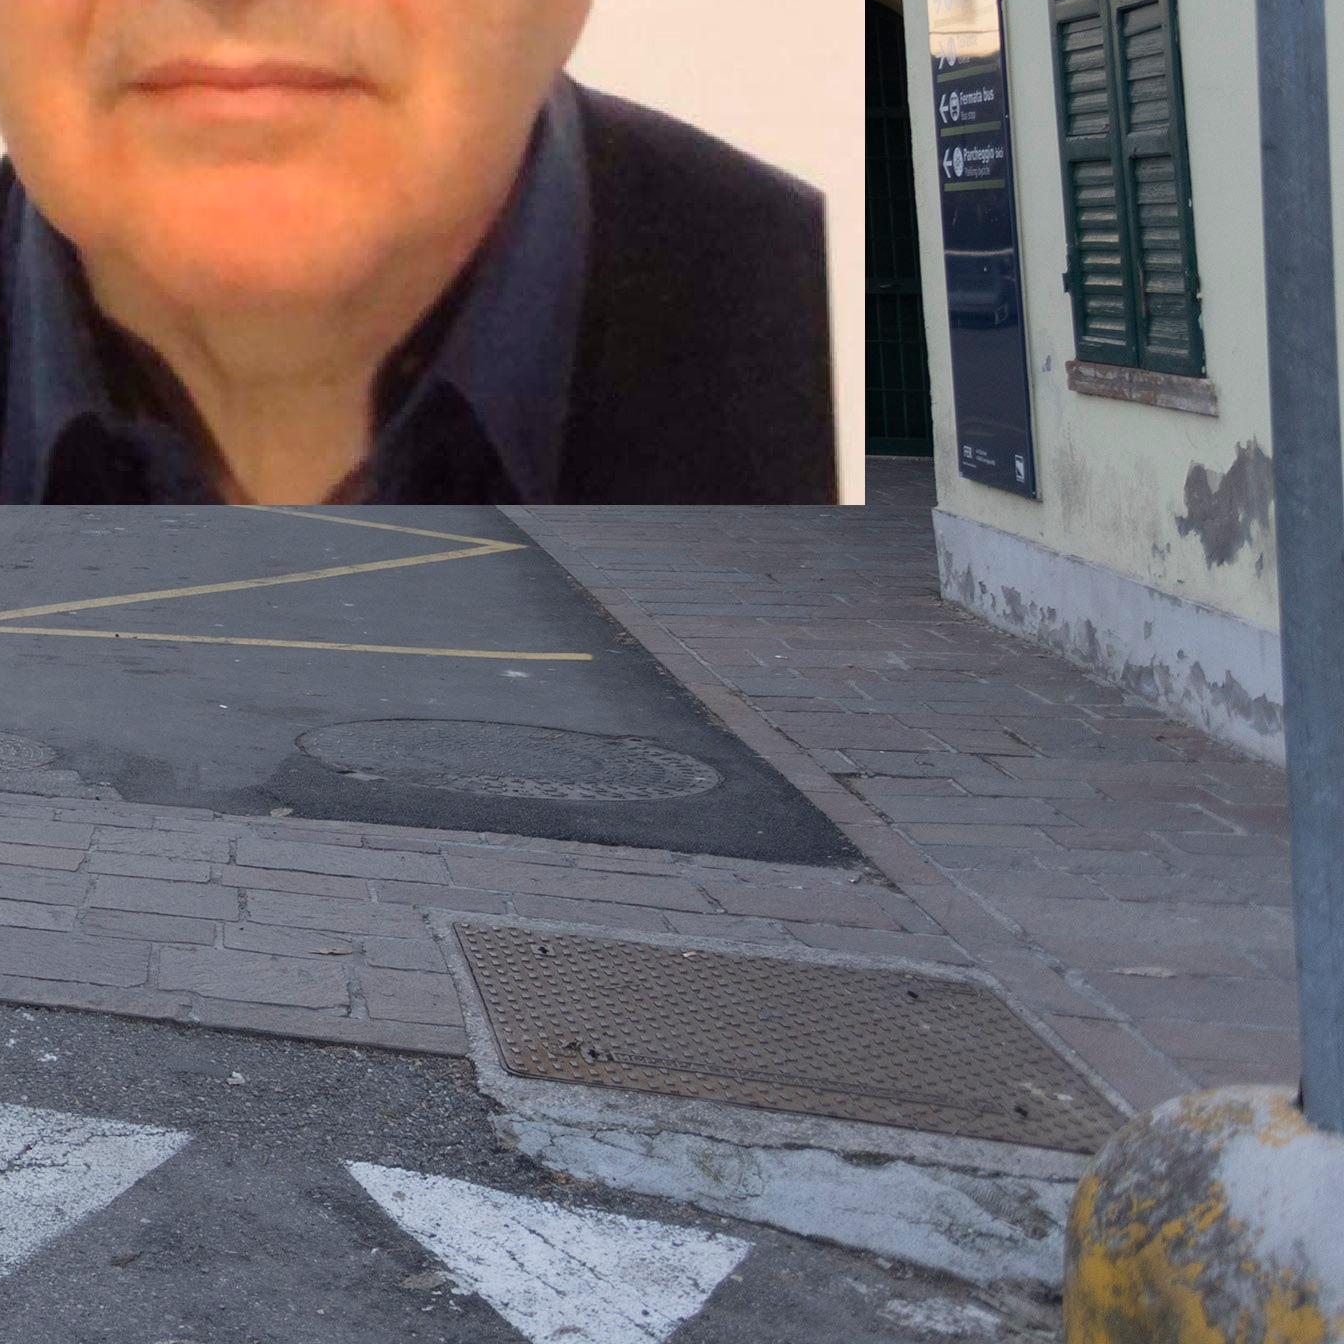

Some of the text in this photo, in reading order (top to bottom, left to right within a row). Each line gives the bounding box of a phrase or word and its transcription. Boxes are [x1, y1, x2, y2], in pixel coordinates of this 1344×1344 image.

[960, 87, 994, 105] Fermata bus
[964, 146, 1004, 163] Parcheggio bici
